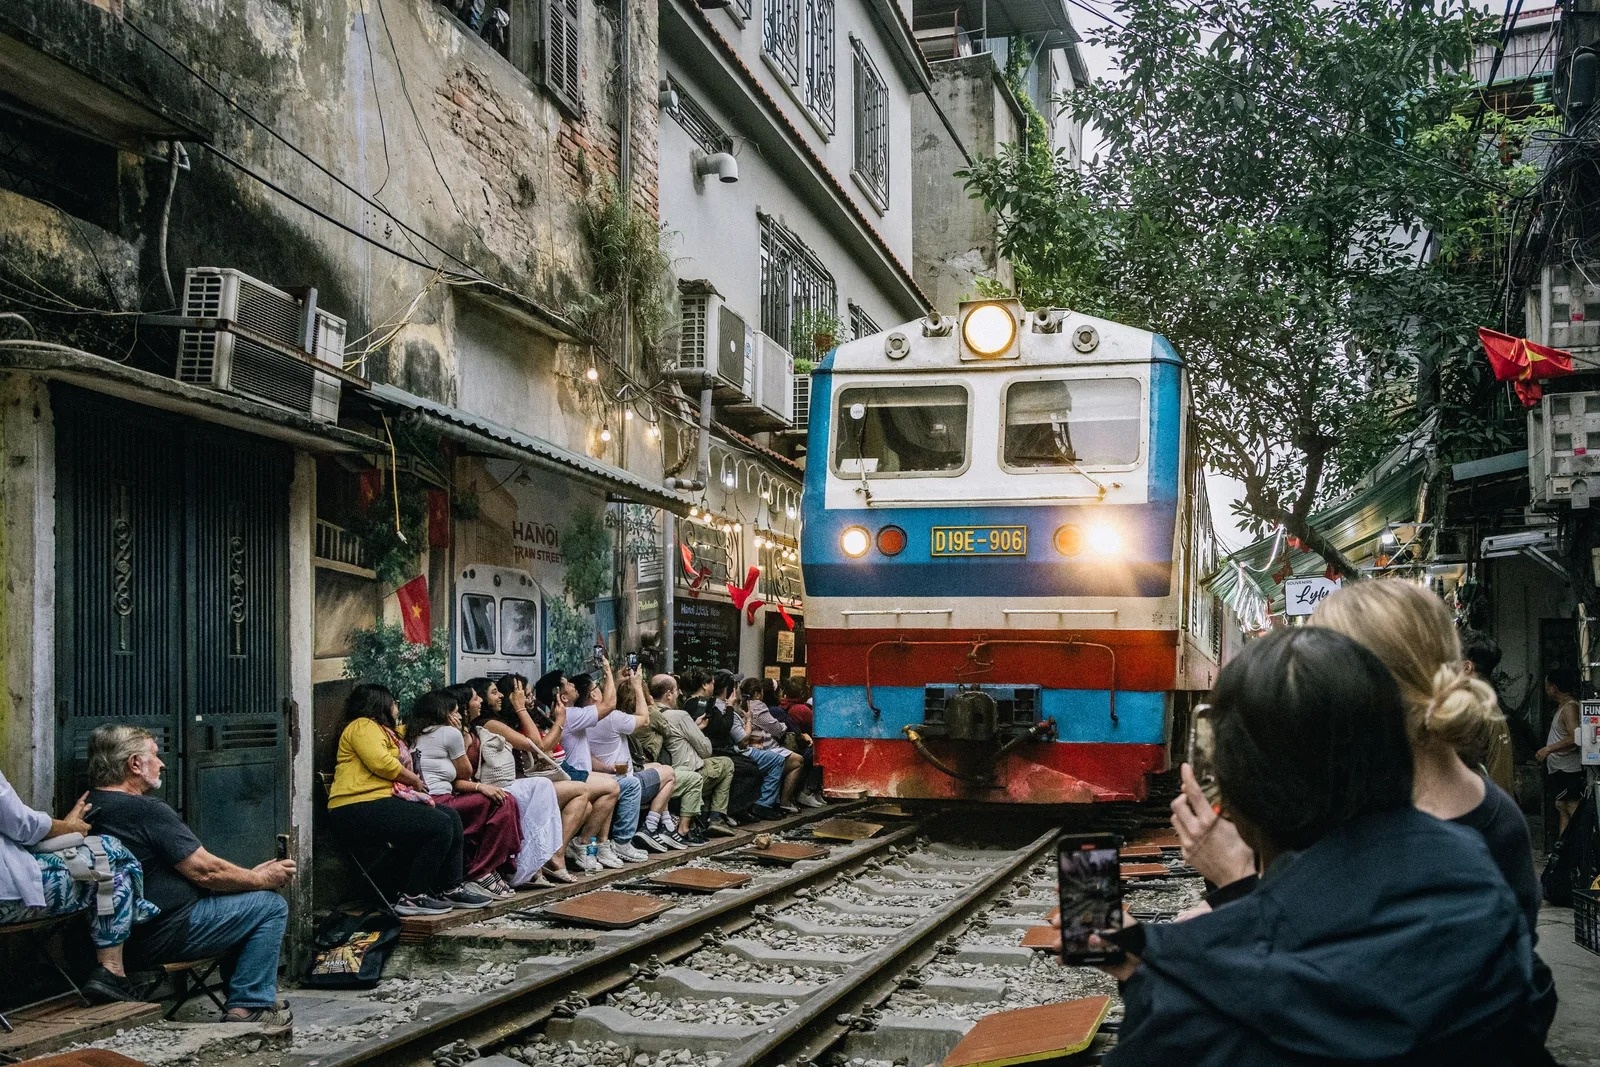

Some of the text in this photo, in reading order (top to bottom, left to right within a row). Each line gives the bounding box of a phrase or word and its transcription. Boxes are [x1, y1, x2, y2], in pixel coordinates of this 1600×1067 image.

[935, 529, 1023, 552] D19E-906
[513, 545, 565, 564] TRAIN STREET
